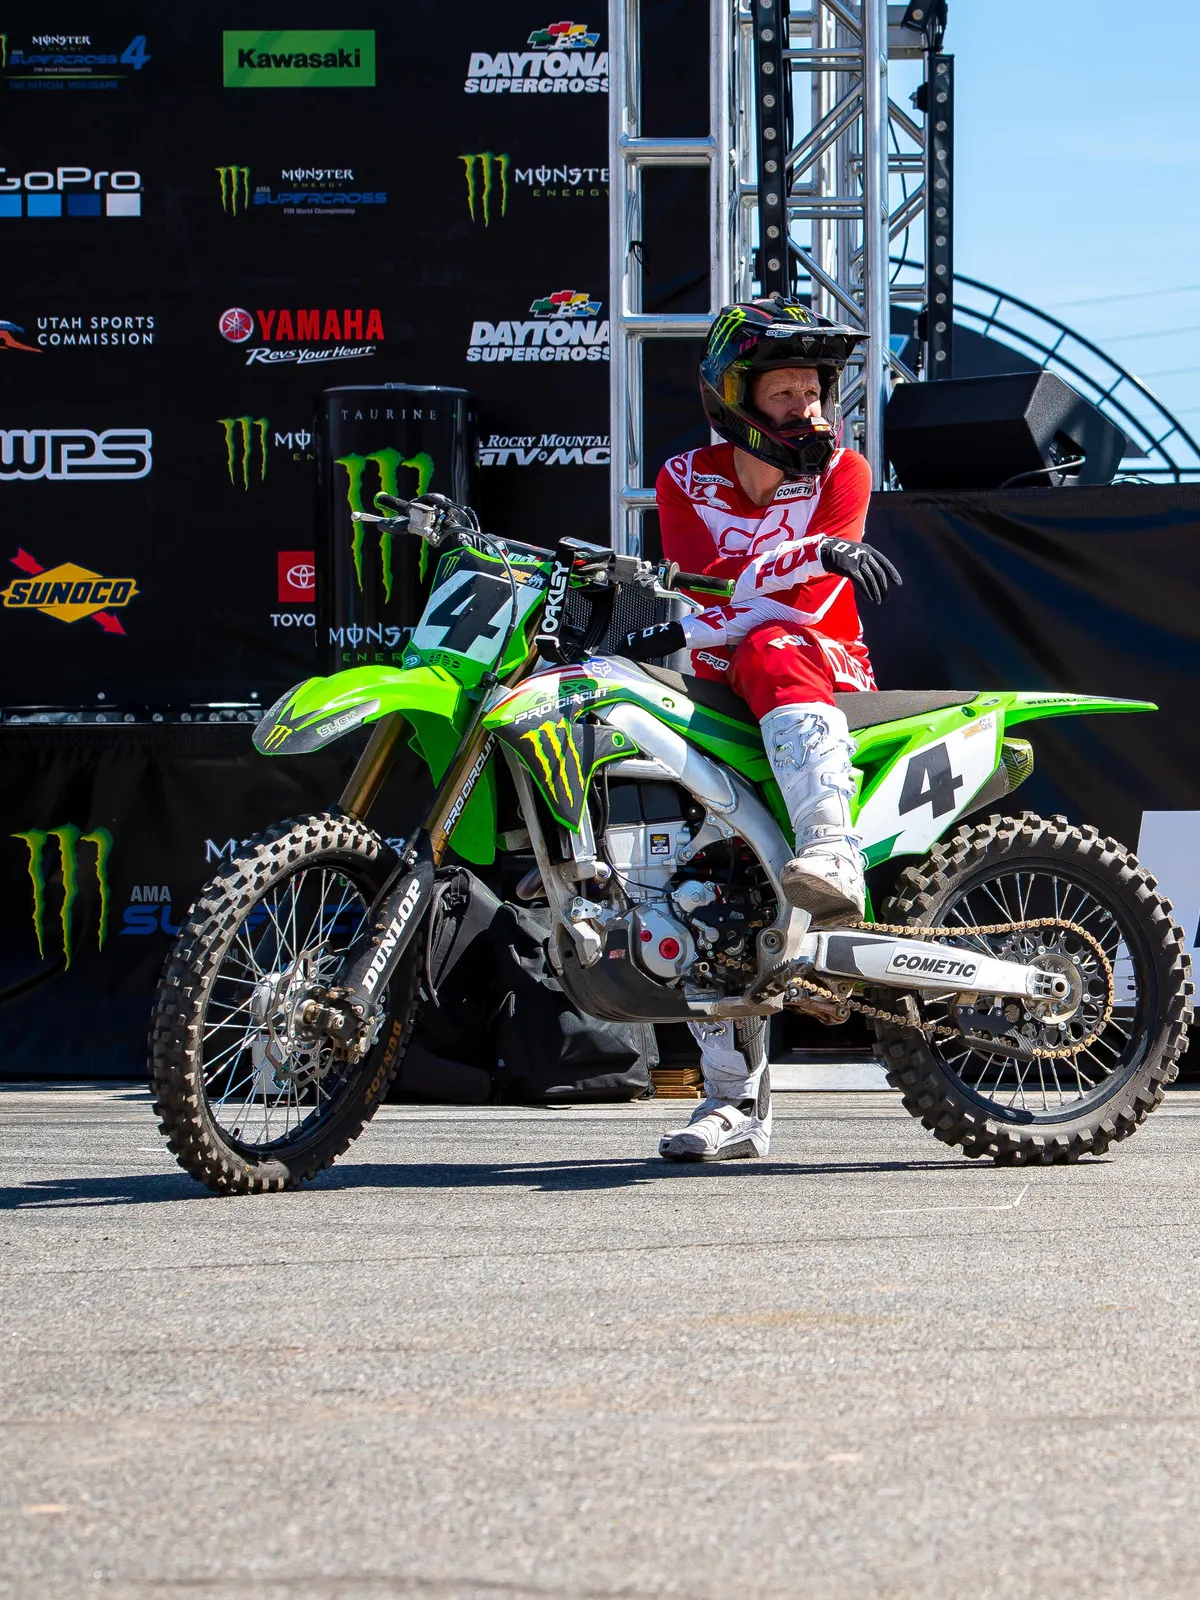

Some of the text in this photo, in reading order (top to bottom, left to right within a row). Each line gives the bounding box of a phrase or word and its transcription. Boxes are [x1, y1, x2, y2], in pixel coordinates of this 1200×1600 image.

[120, 34, 152, 71] 4
[237, 47, 362, 69] Kawasaki
[467, 51, 609, 78] DAYTONA
[281, 167, 354, 181] MONSTER
[514, 165, 609, 187] MONSTE
[253, 191, 388, 205] SUPERCROSS
[37, 316, 155, 330] UTAH SPORTS
[256, 308, 385, 342] YAMAHA
[469, 320, 610, 347] DAYTONA
[37, 332, 154, 346] COMMISSION
[341, 408, 437, 421] TAURINE
[537, 433, 610, 448] MOUNTAI
[776, 485, 812, 497] COMETI
[755, 541, 822, 590] FOX
[10, 581, 135, 605] SUNOCO
[542, 561, 569, 633] OAKLEY
[270, 613, 316, 629] TOYO
[426, 574, 521, 653] 4
[329, 622, 417, 649] MONST
[626, 622, 670, 647] FOX
[768, 635, 812, 649] FOX
[343, 652, 402, 662] ENER
[698, 651, 730, 671] PRO
[515, 686, 610, 725] PRO CIRCUIT
[443, 731, 497, 836] PRO CIRCUIT
[898, 742, 963, 820] 4
[131, 885, 171, 903] AMA
[361, 878, 422, 994] DUNLOP
[892, 953, 977, 979] COMETIC
